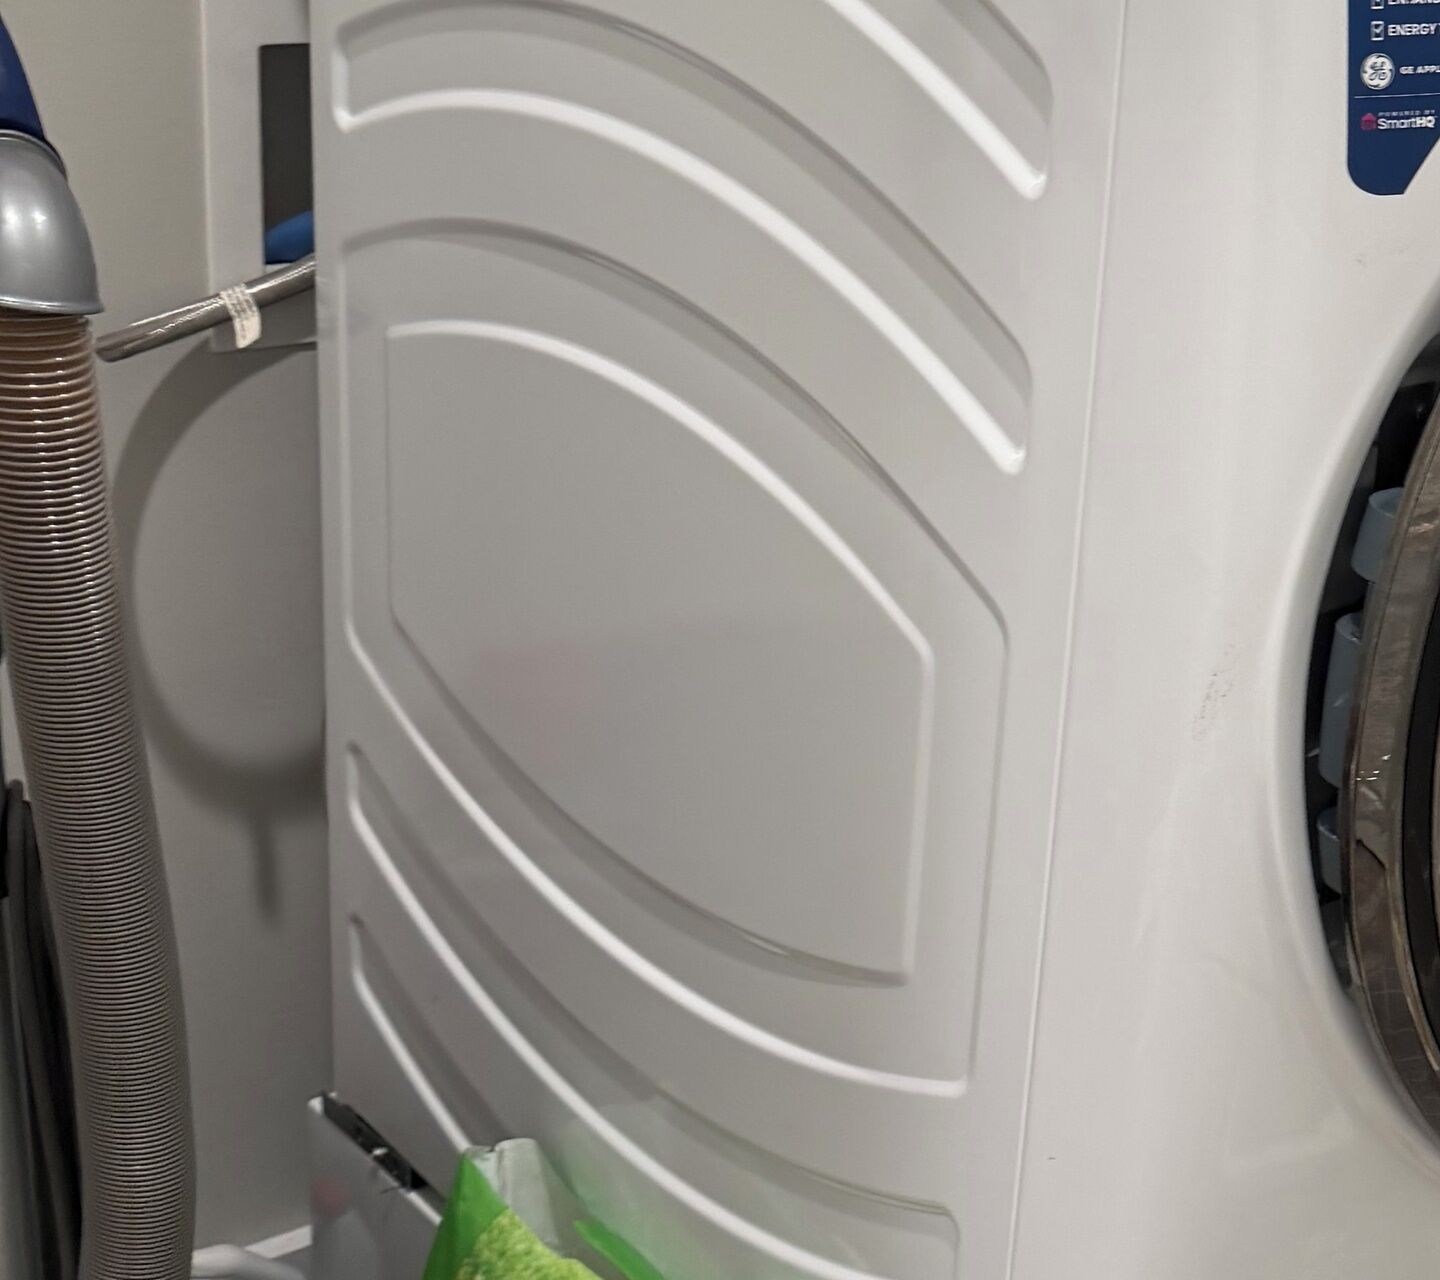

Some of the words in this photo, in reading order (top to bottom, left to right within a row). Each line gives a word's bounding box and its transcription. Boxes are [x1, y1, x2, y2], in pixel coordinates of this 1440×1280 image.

[1388, 23, 1437, 36] ENERGY
[1400, 66, 1414, 75] GE
[1377, 116, 1436, 130] SmartHQ
